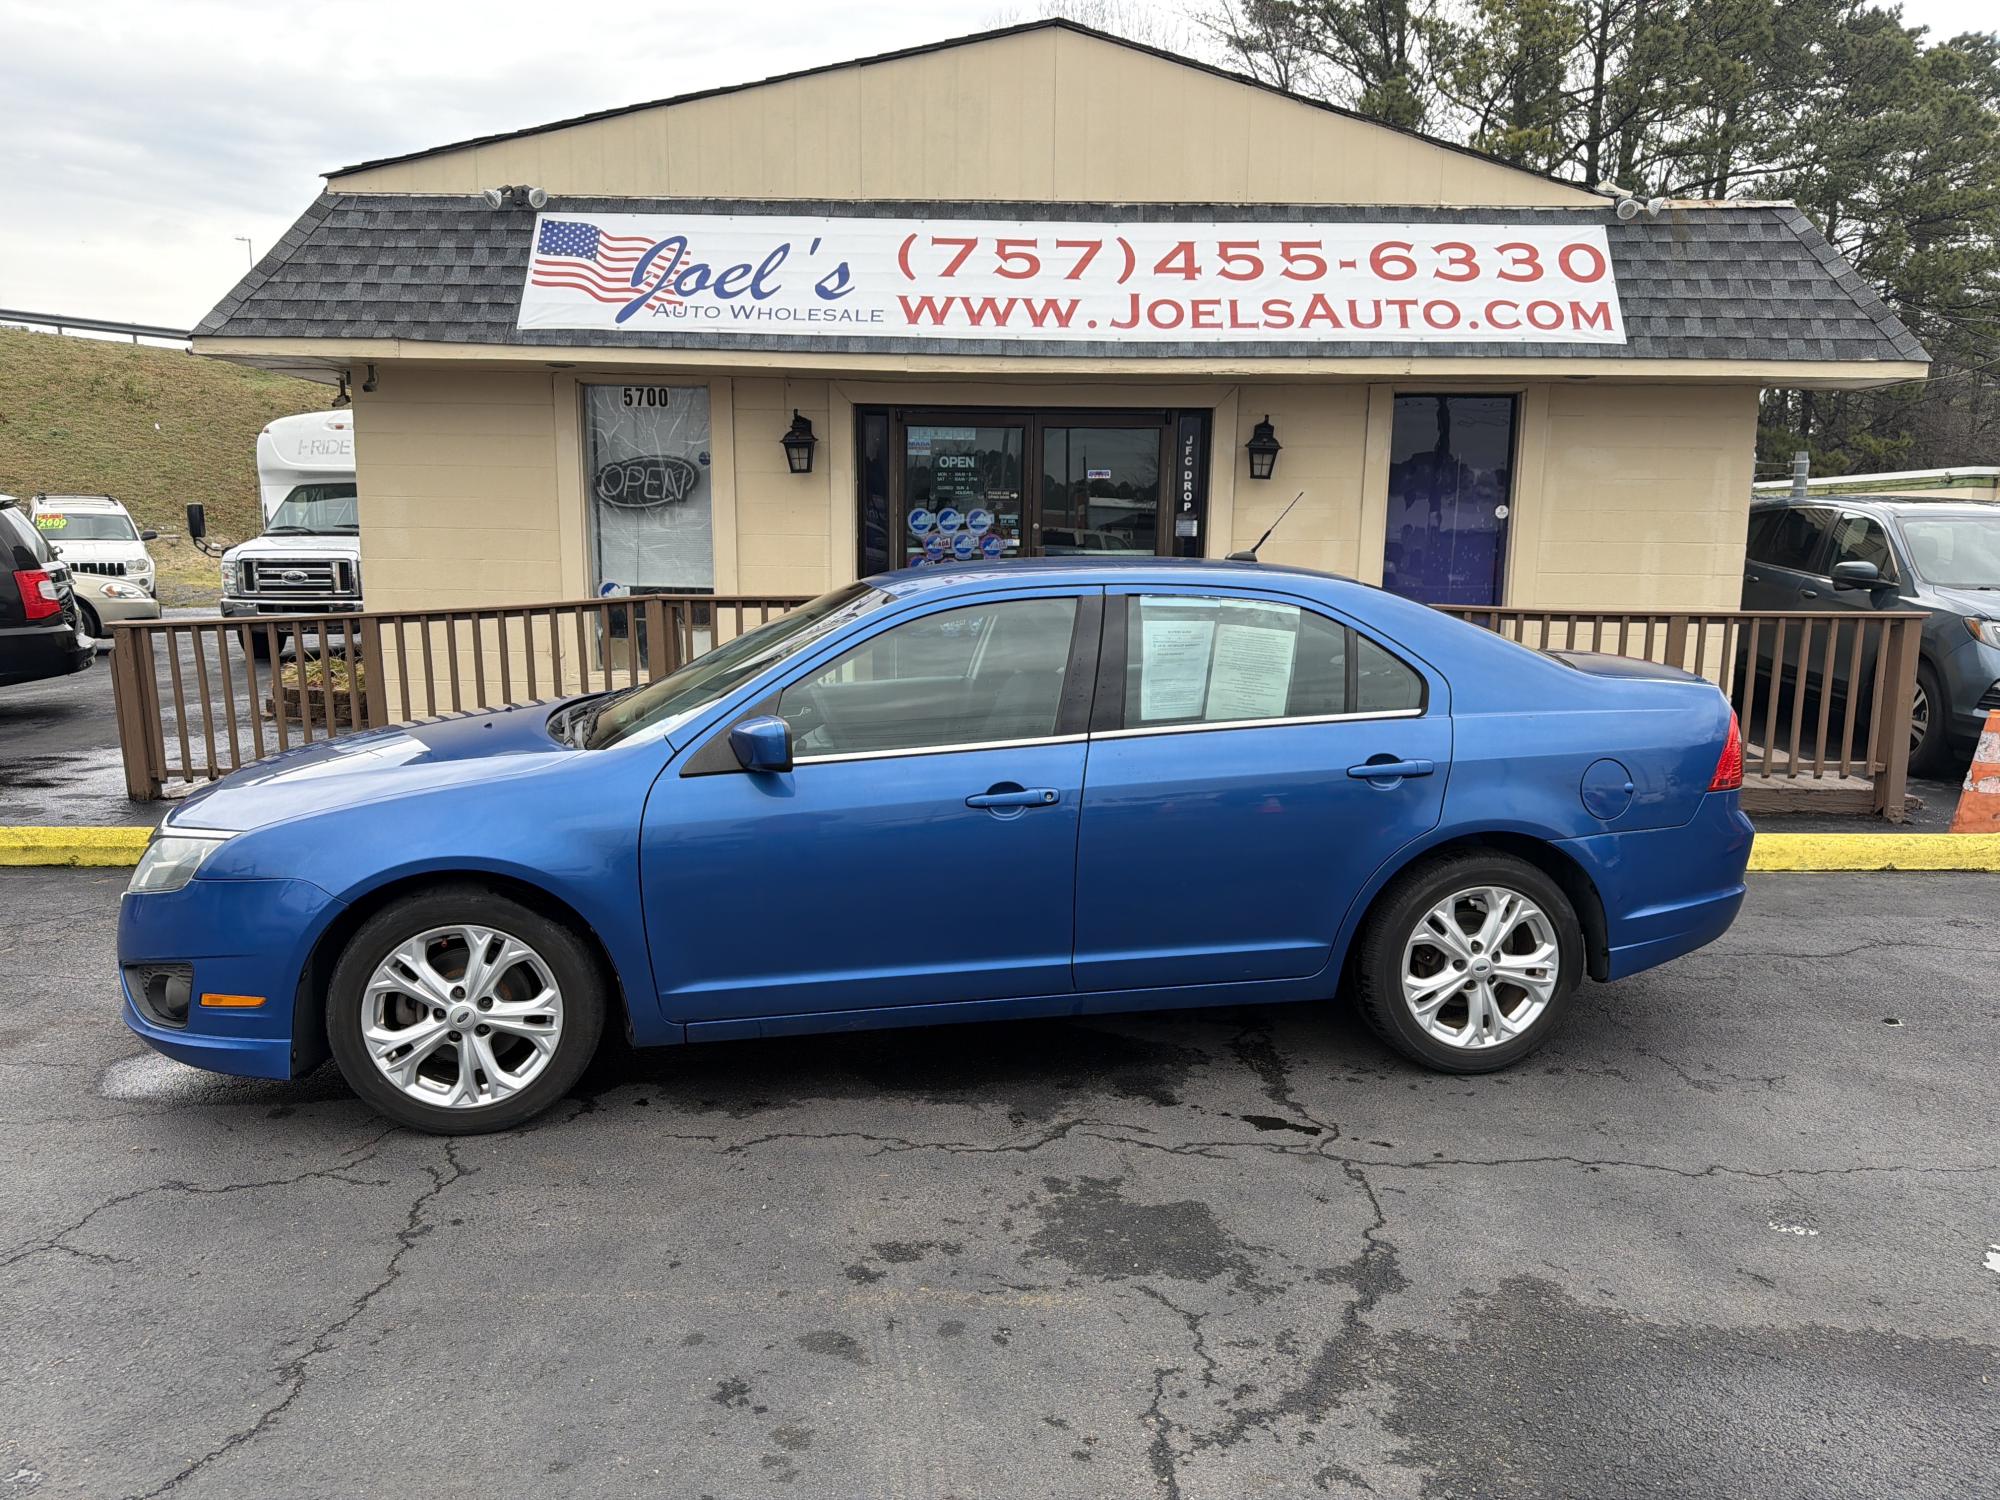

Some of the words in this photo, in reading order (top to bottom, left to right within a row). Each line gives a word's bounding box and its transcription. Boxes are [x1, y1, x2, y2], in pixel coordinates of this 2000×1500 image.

[898, 236, 1606, 283] (757)455-6330
[615, 236, 856, 324] Joel's
[653, 303, 721, 320] AUTO
[730, 304, 885, 323] WHOLESALE
[623, 387, 669, 408] 5700
[939, 455, 975, 469] OPEN
[1184, 435, 1194, 466] JFC
[601, 464, 688, 500] OPEN
[1183, 470, 1193, 512] DROP
